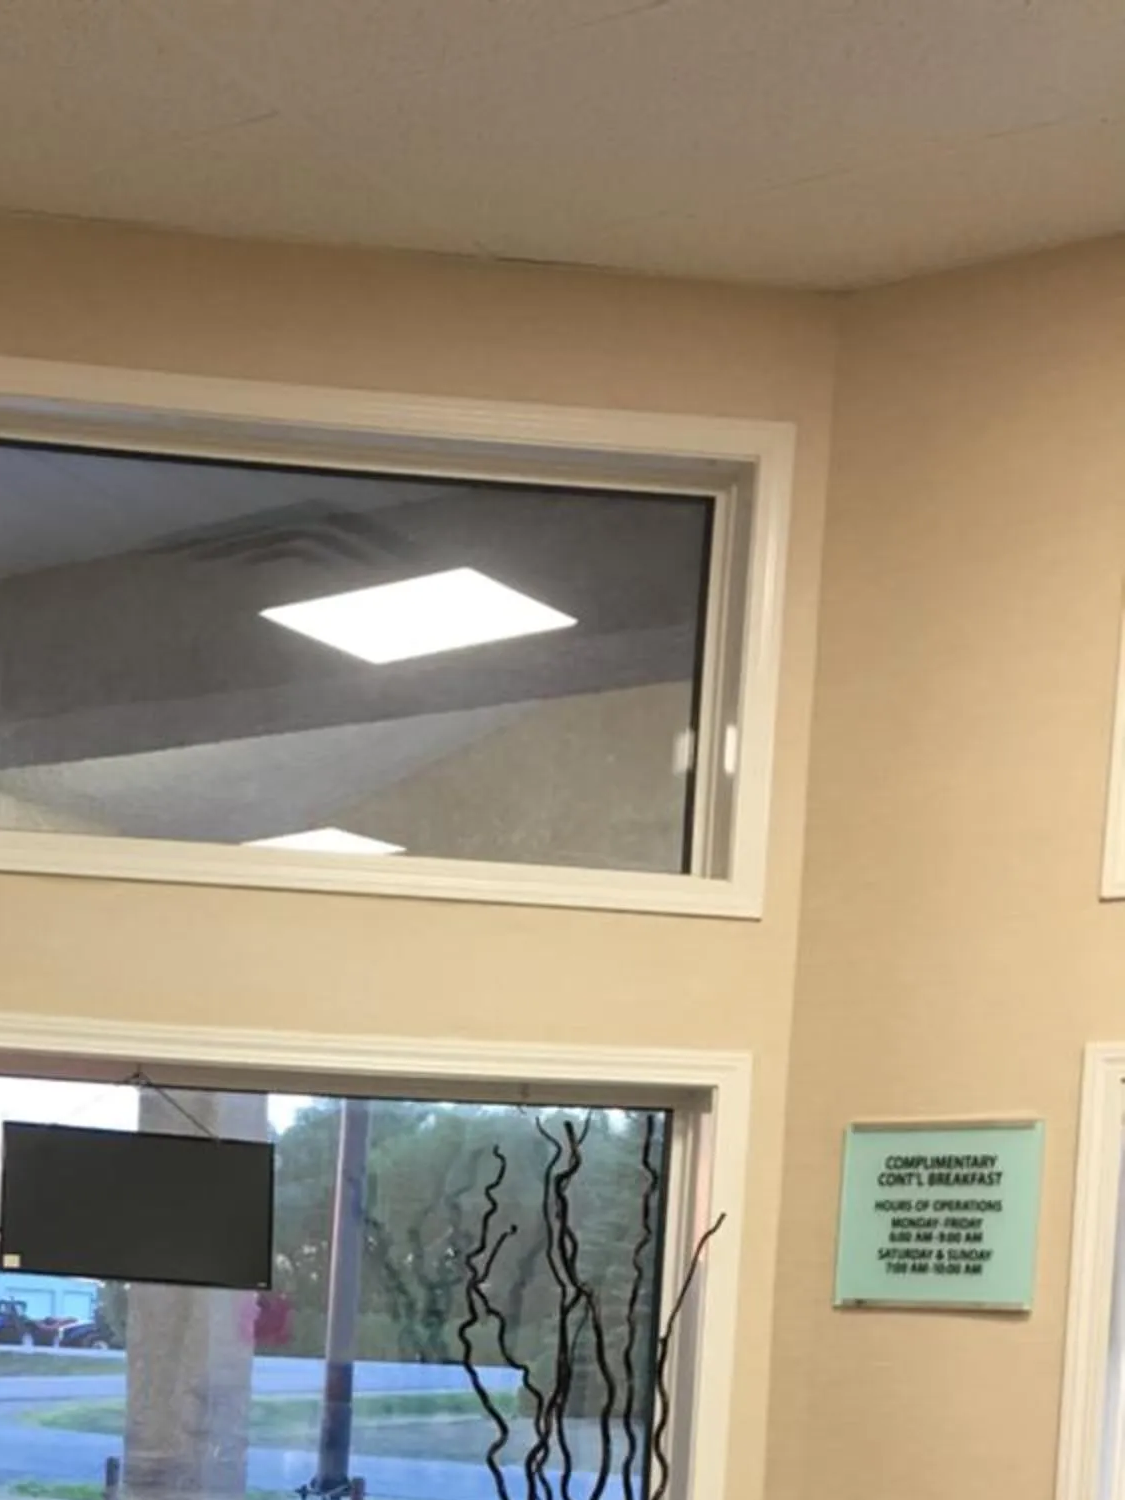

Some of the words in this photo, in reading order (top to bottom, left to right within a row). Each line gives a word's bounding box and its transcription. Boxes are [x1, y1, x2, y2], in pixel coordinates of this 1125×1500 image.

[885, 1155, 998, 1170] COMPLIMENTARY
[877, 1172, 923, 1187] CONT'L
[927, 1172, 1003, 1187] BREAKFAST
[875, 1199, 912, 1212] HOURS
[915, 1199, 930, 1212] OF
[933, 1199, 1002, 1212] OPERATIONS
[965, 1231, 983, 1243] AM
[877, 1248, 933, 1260] SATURDAY
[936, 1249, 945, 1261] &
[947, 1248, 993, 1261] SUNDAY
[965, 1263, 982, 1275] AM
